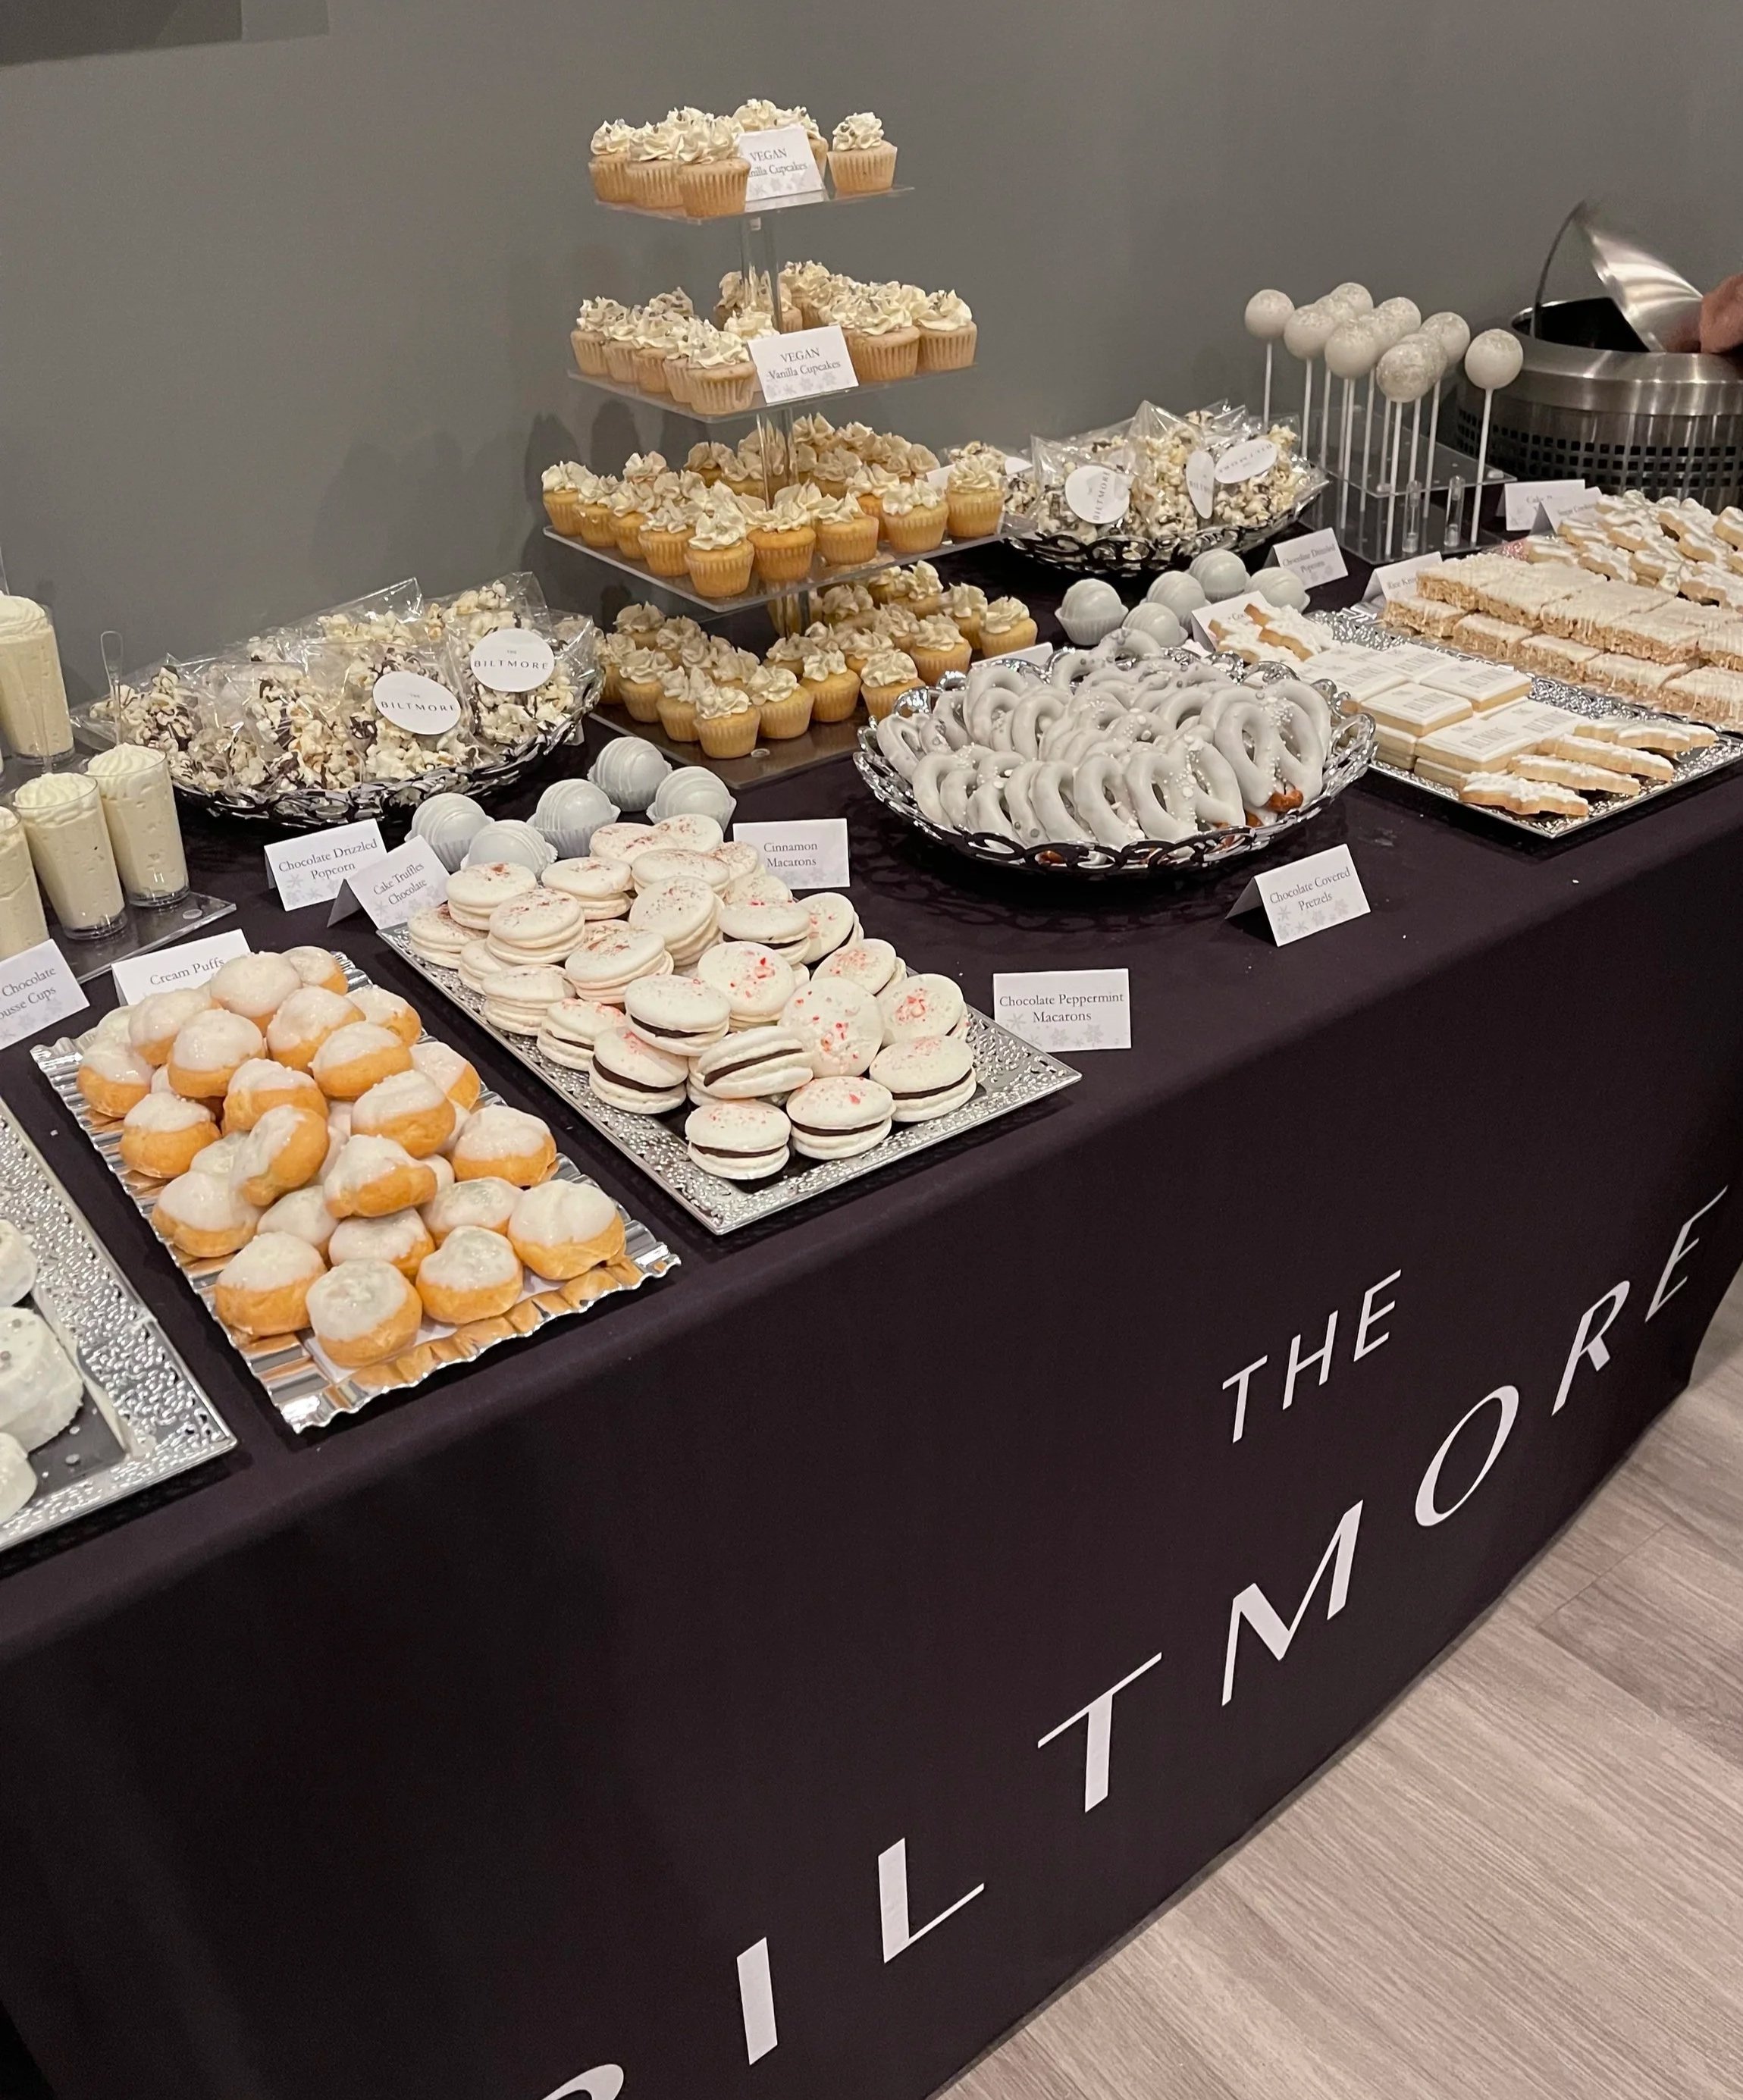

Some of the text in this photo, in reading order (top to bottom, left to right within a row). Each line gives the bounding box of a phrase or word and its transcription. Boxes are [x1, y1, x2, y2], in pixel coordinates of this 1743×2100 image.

[750, 148, 787, 162] VEGAN
[749, 161, 807, 177] nilla Cupcakes
[780, 347, 820, 362] VEGAN
[769, 361, 841, 380] Vanilla Cupcakes
[474, 659, 549, 670] BILTMORE
[381, 701, 455, 712] BILTMORE
[278, 838, 378, 873] Chocolate Drizzled
[763, 842, 817, 853] Cinnamon
[310, 863, 356, 880] Popcorn
[766, 857, 817, 868] Macarons
[373, 863, 425, 895] Cake Truffles
[1270, 867, 1351, 904] Chocolate Covered
[387, 879, 428, 905] Chocolate
[1298, 892, 1333, 911] Pretzels
[149, 957, 225, 986] Cream Puffs
[2, 967, 57, 997] Chocolate
[0, 986, 57, 1020] ousse Cups
[999, 992, 1124, 1007] Chocolate Peppermint
[1033, 1011, 1092, 1023] Macarons
[1222, 1269, 1401, 1443] THE
[541, 1186, 1728, 2100] ILTMORE
